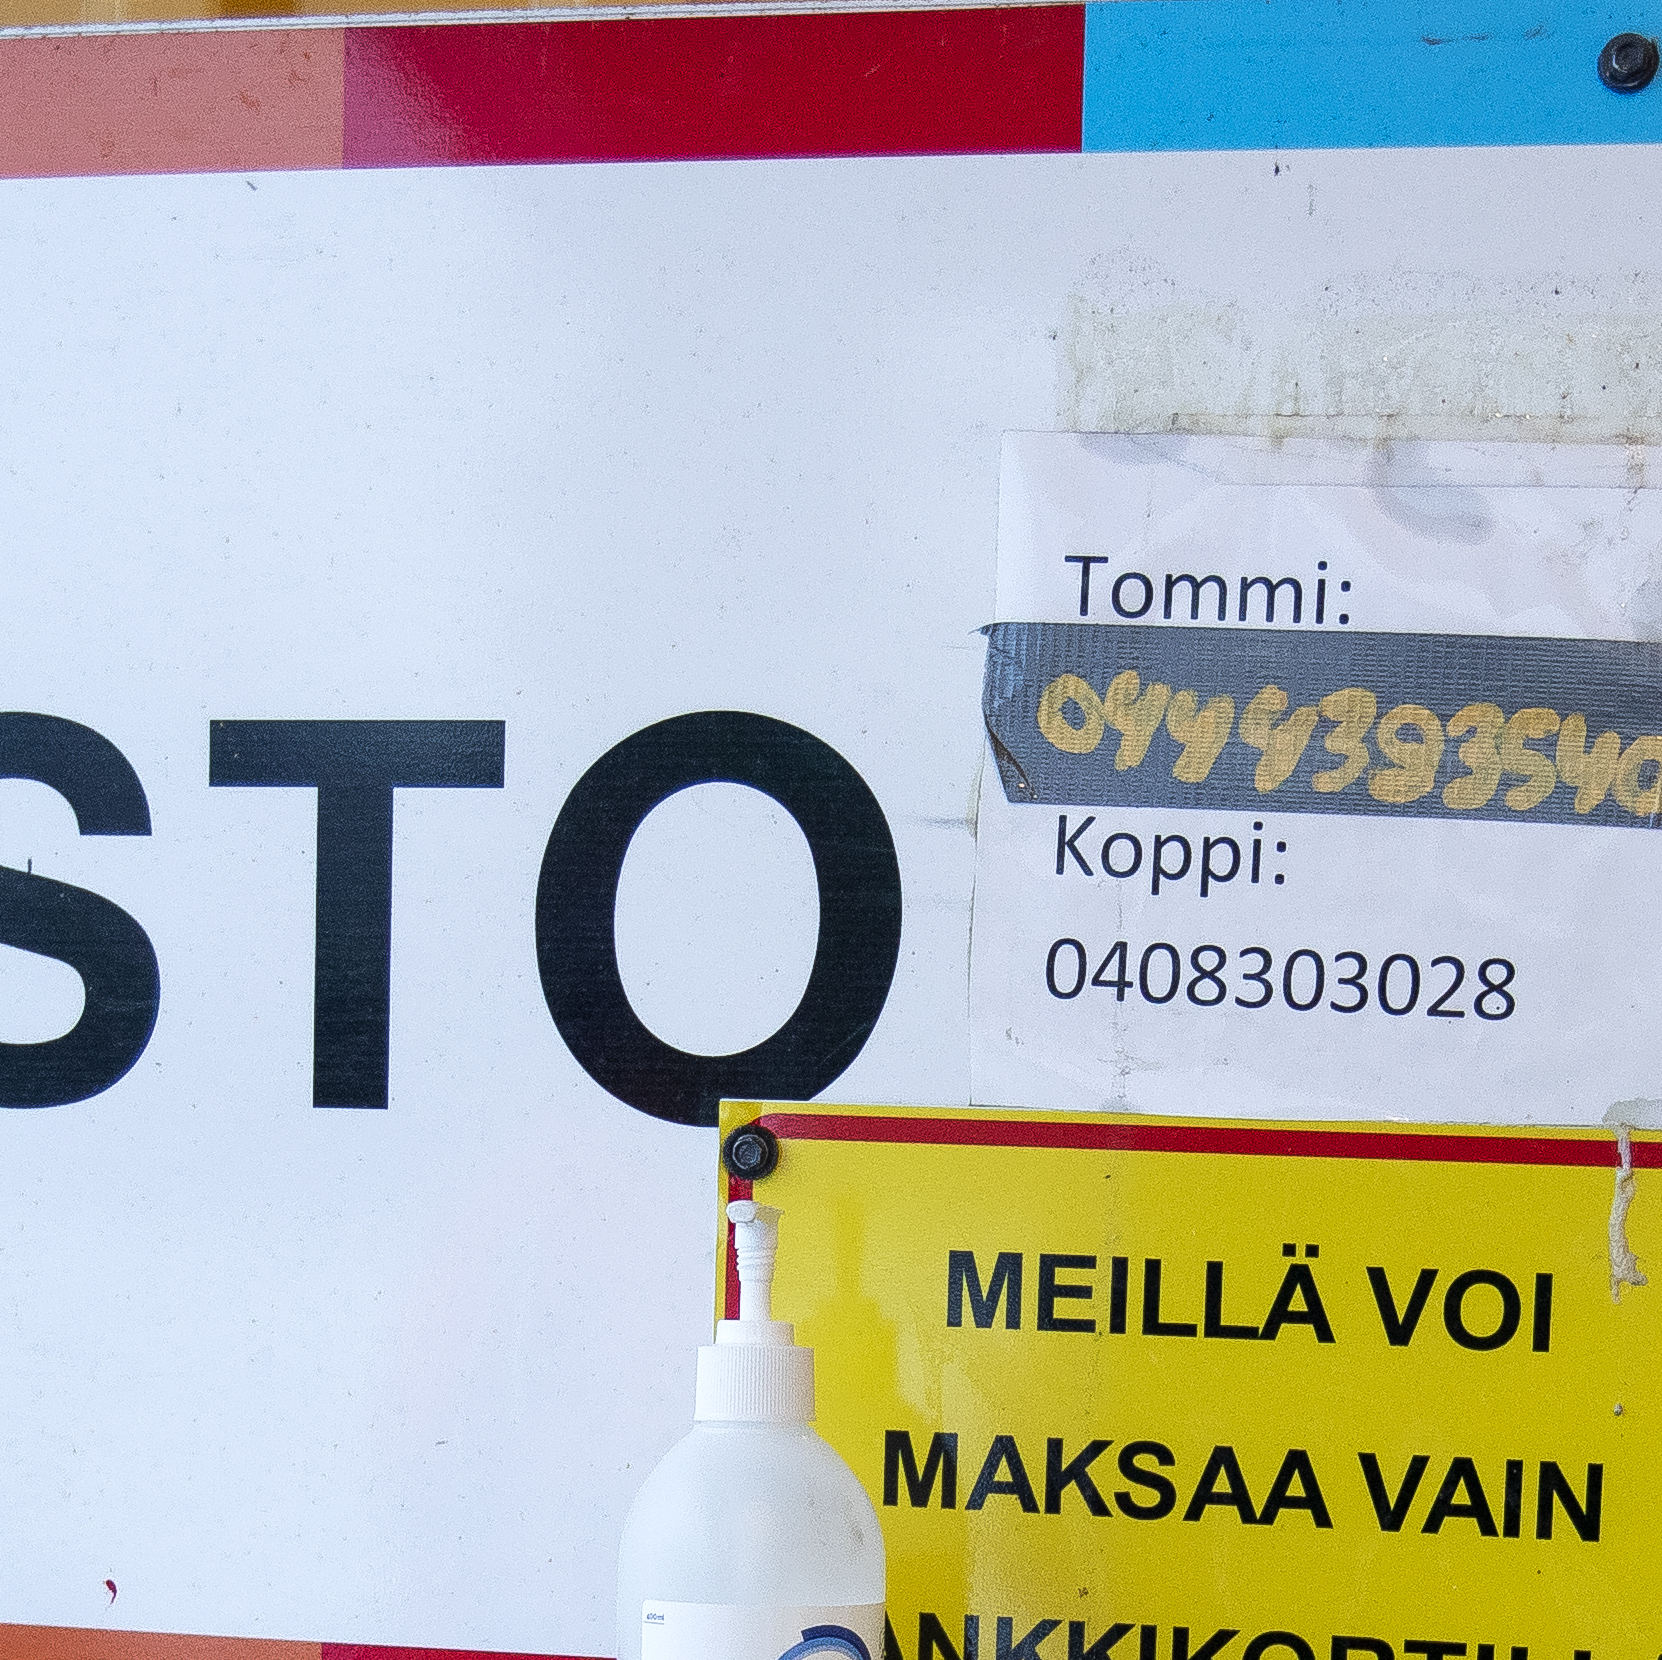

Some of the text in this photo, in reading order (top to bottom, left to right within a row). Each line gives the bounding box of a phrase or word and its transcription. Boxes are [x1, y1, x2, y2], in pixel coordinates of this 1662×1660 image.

[1065, 555, 1351, 625] Tommi:
[1056, 814, 1287, 898] Koppi:
[1045, 938, 1516, 1021] 0408303028
[946, 1242, 1554, 1352] MEILLÄ VOI
[882, 1429, 1603, 1542] MAKSAA VAIN
